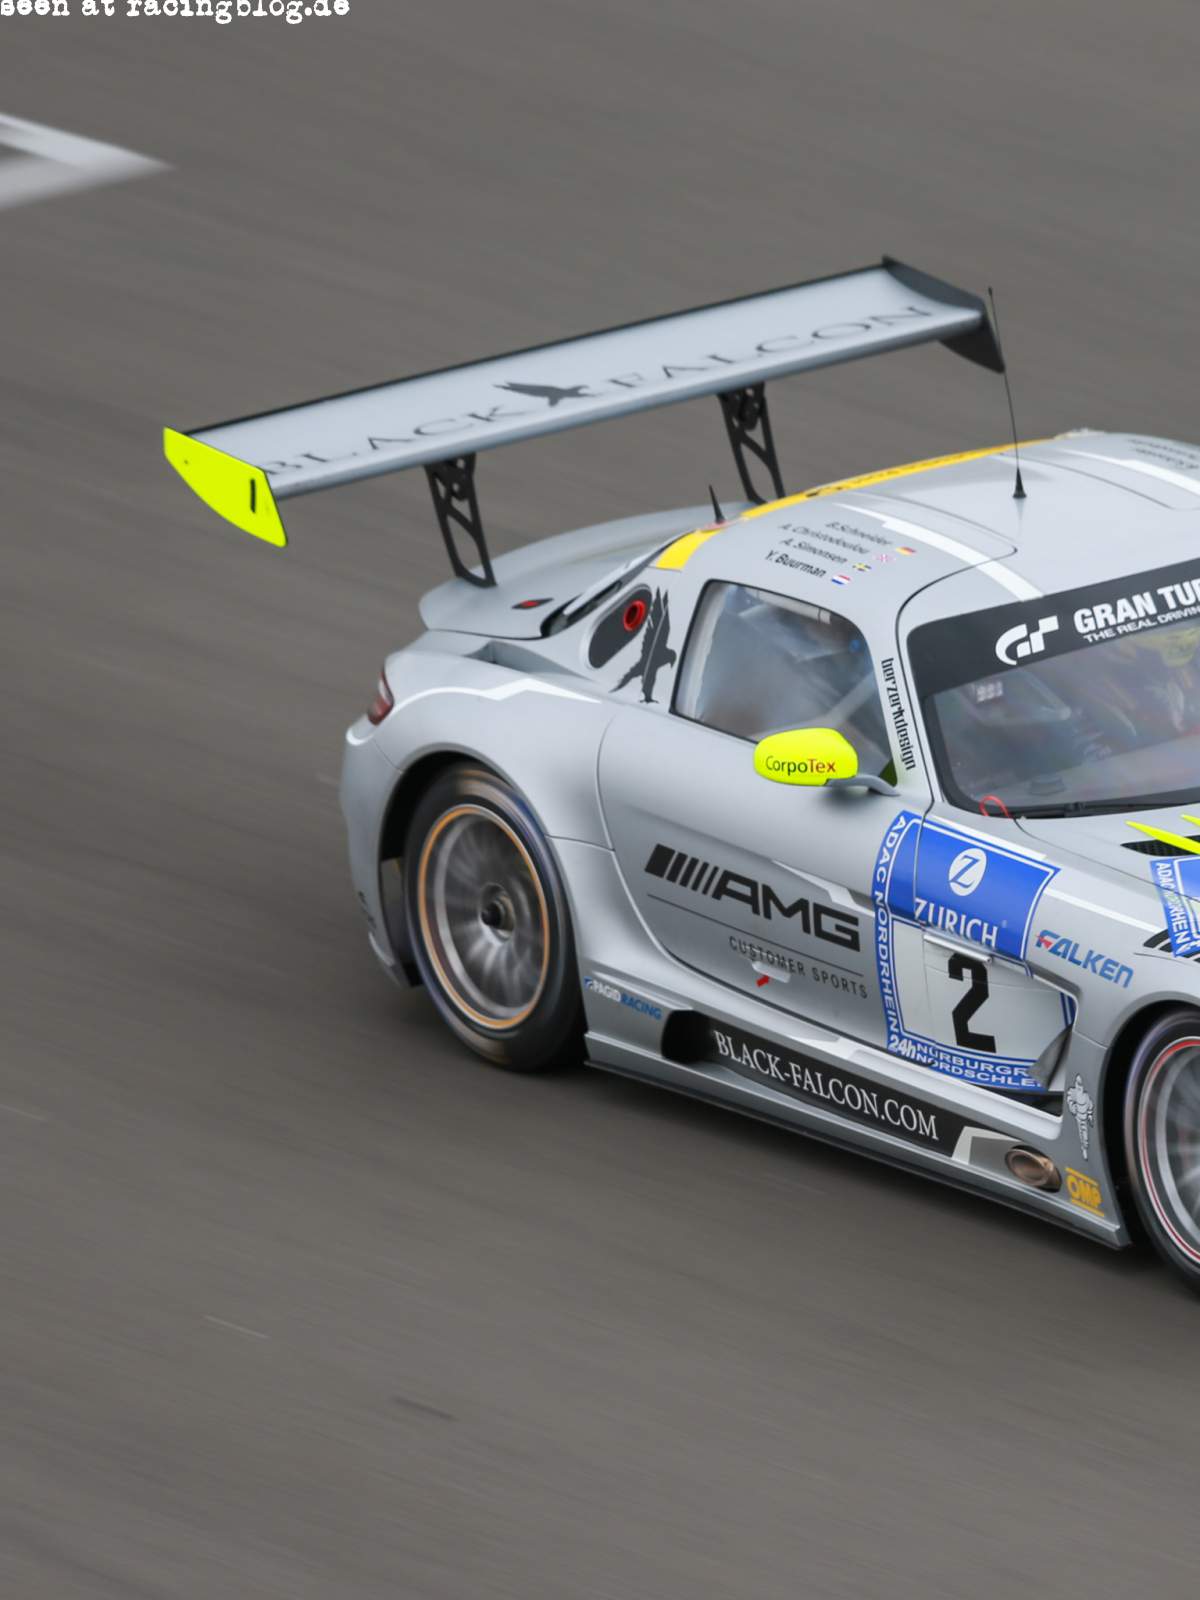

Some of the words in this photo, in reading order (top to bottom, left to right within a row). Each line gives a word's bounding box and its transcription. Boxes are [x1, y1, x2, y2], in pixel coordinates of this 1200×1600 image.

[610, 305, 932, 389] FALCON
[775, 553, 827, 578] Buurman
[1073, 591, 1158, 635] GRAN
[1083, 628, 1116, 644] THE
[1116, 618, 1157, 636] REAL
[765, 756, 836, 776] CorpoTex
[875, 816, 907, 882] ADAC
[711, 869, 860, 952] AMG
[914, 897, 998, 948] ZURICH
[729, 935, 805, 976] CUSTOMER
[812, 967, 868, 999] SPORTS
[875, 891, 899, 1034] NORDRHEIN
[1035, 929, 1134, 989] FALKEN
[948, 952, 997, 1053] 2
[888, 1035, 916, 1059] 24h
[712, 1029, 940, 1141] BLACK-FALCON.COM
